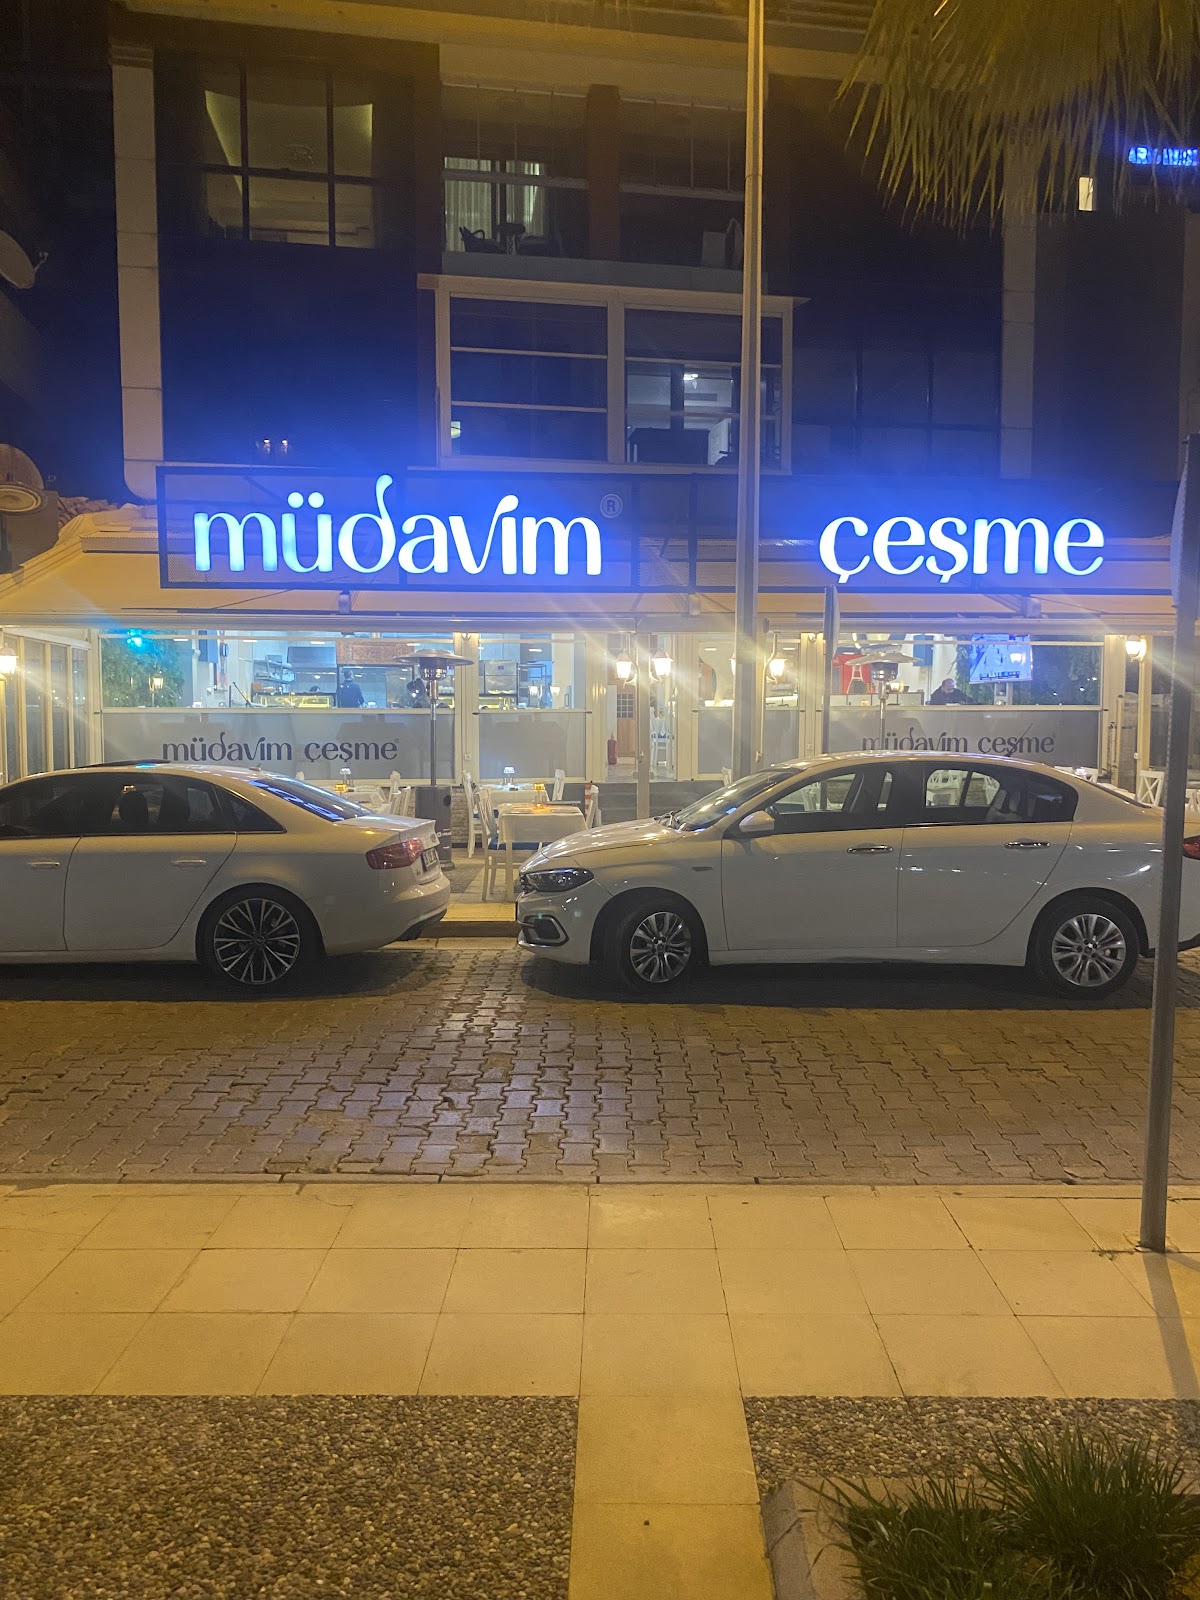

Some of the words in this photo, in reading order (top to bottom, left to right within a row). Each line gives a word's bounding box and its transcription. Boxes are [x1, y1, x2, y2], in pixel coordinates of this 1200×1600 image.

[194, 474, 603, 576] müdavim
[819, 516, 1106, 584] çeşme
[162, 731, 293, 761] müdavim
[303, 741, 399, 763] çeşme
